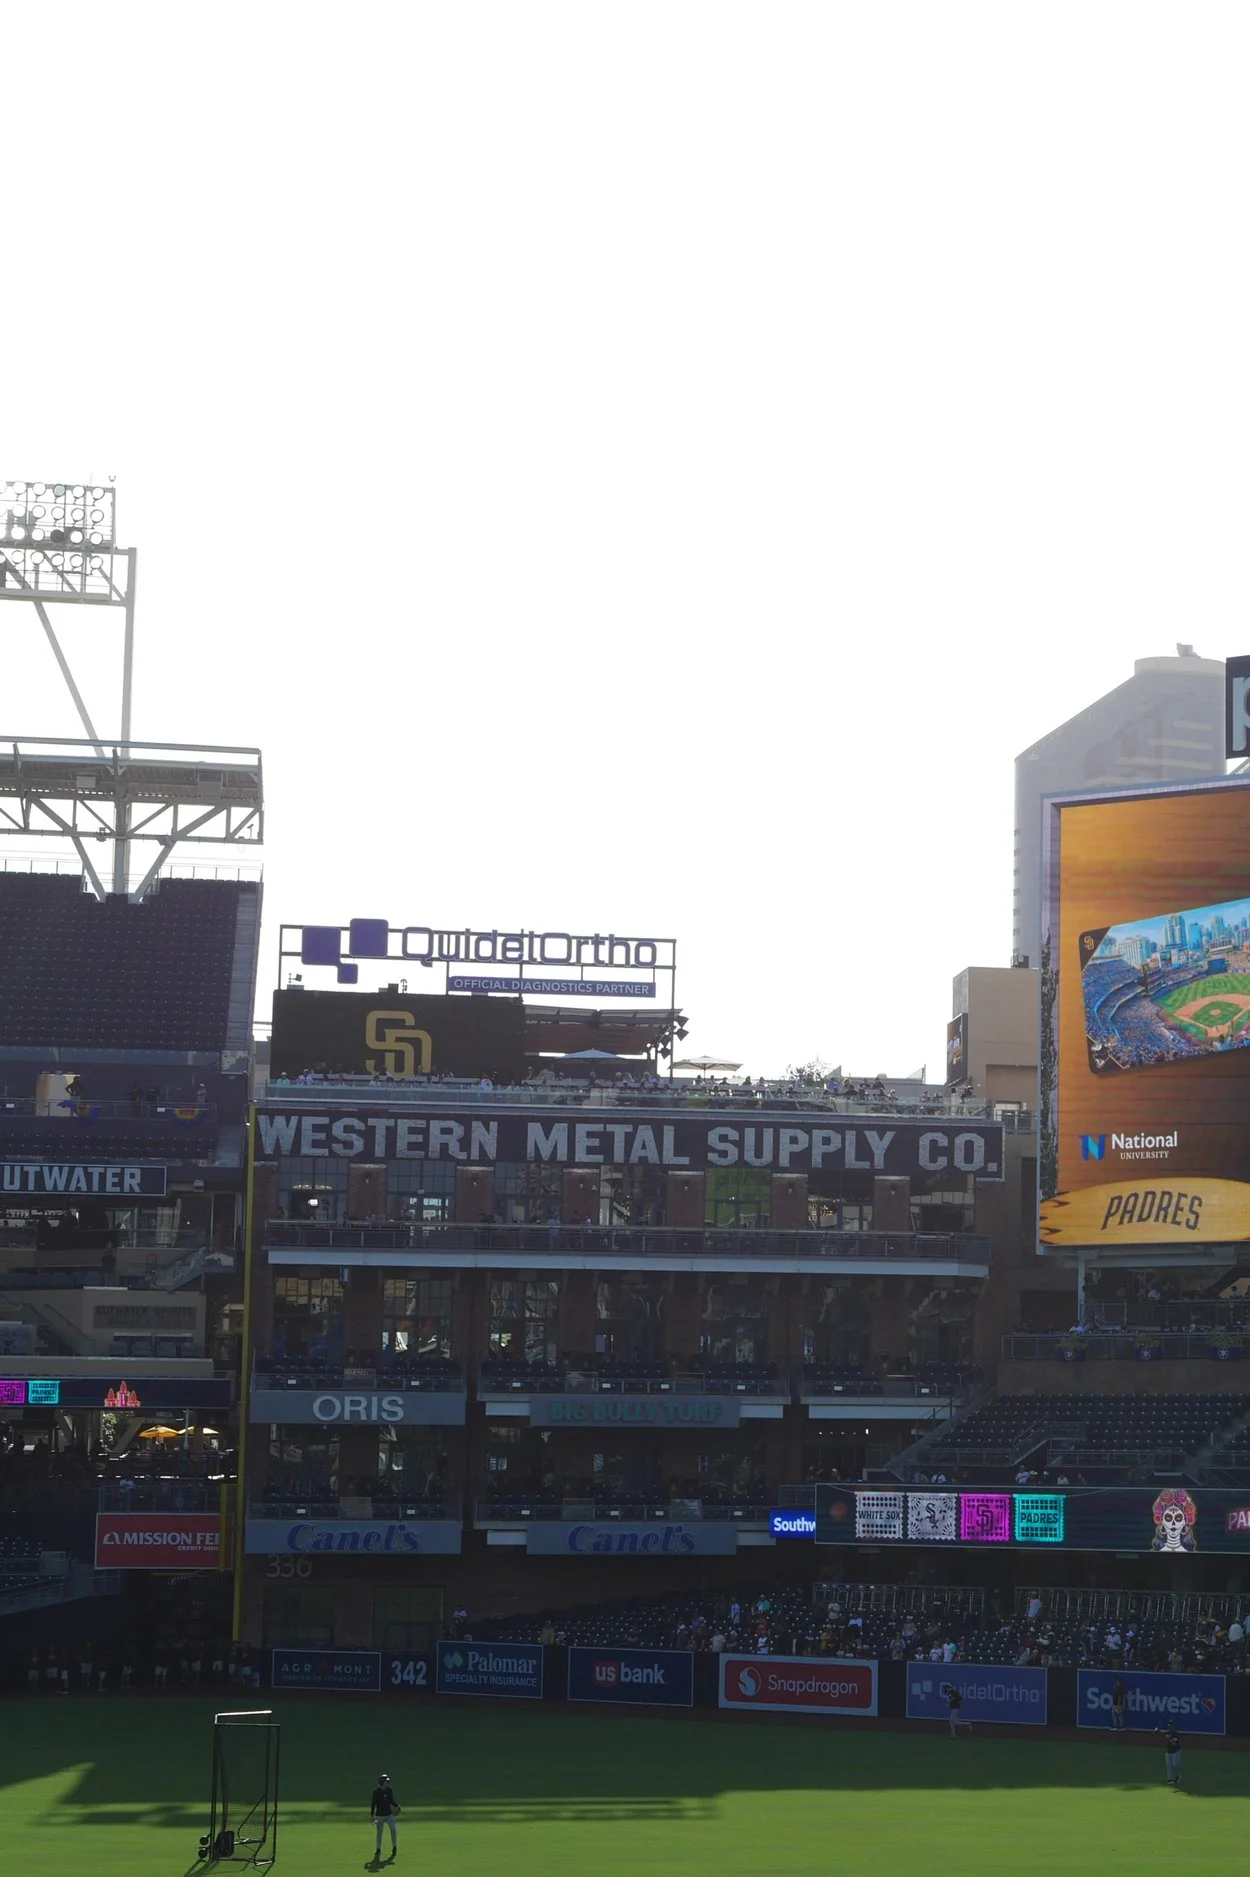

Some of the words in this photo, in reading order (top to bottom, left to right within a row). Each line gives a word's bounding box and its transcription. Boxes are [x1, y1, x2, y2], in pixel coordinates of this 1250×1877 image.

[401, 926, 658, 969] QuidelOrtho
[453, 977, 504, 991] OFFICIAL
[507, 979, 593, 993] DIAGNOSTICS
[596, 982, 650, 995] PARTNER
[257, 1114, 498, 1160] WESTERN
[526, 1122, 690, 1165] METAL
[706, 1126, 896, 1169] SUPPLY
[918, 1131, 998, 1172] CO.
[1111, 1130, 1178, 1150] National
[1120, 1150, 1169, 1160] UNIVERSITY
[0, 1164, 142, 1193] UTWATER
[1100, 1190, 1203, 1231] PADRES
[312, 1395, 405, 1422] ORIS
[858, 1509, 883, 1521] WHITE
[885, 1510, 901, 1521] SOX
[1020, 1512, 1059, 1525] PADRES
[123, 1532, 192, 1545] MISSION
[286, 1523, 419, 1553] Canel's
[567, 1525, 697, 1554] Canel's
[265, 1554, 312, 1578] 336
[391, 1660, 428, 1686] 342
[467, 1650, 537, 1674] Palomar
[595, 1665, 616, 1682] us
[620, 1661, 666, 1685] bank
[444, 1673, 489, 1685] SPECIALTY
[489, 1675, 537, 1688] INSURANCE
[767, 1674, 858, 1698] Snapdragon
[1086, 1686, 1200, 1715] Sothwest
